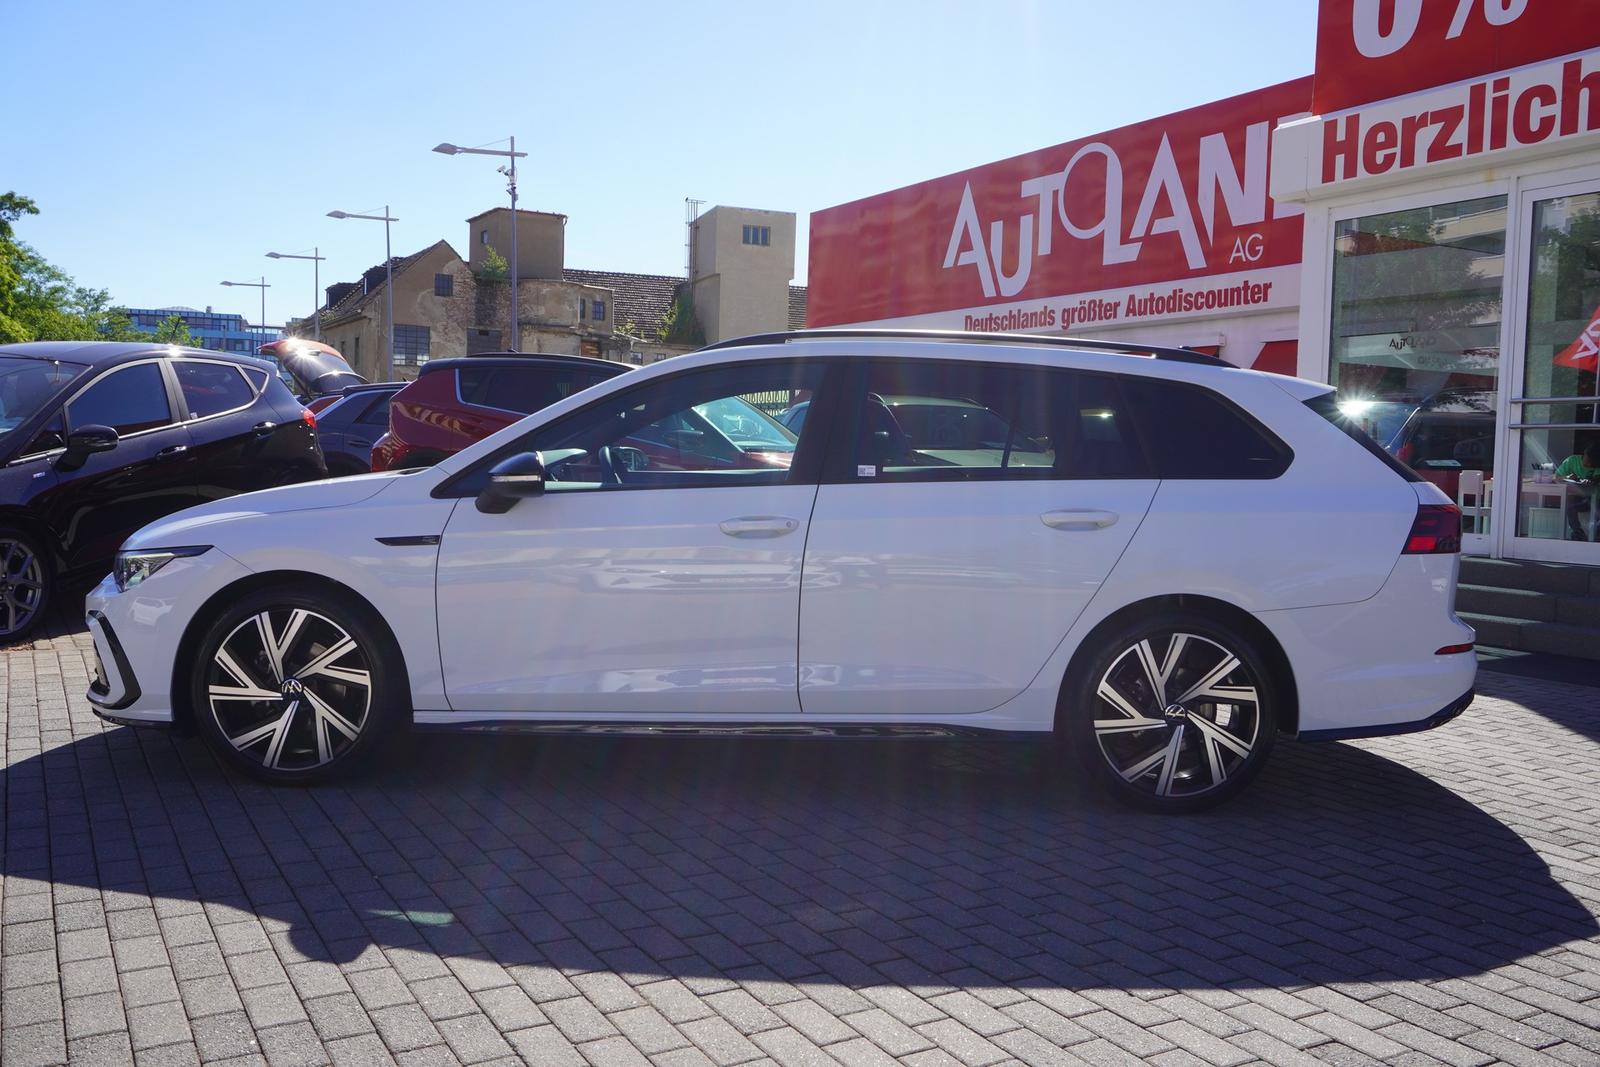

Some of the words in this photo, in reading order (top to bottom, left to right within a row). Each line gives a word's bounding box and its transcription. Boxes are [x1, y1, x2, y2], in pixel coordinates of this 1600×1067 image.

[1352, 0, 1529, 59] 0
[942, 111, 1313, 298] AUTOLAN
[1228, 232, 1264, 265] AG
[964, 305, 1056, 332] Deutschlands
[1061, 299, 1121, 330] größter
[1125, 279, 1273, 317] Autodiscounter
